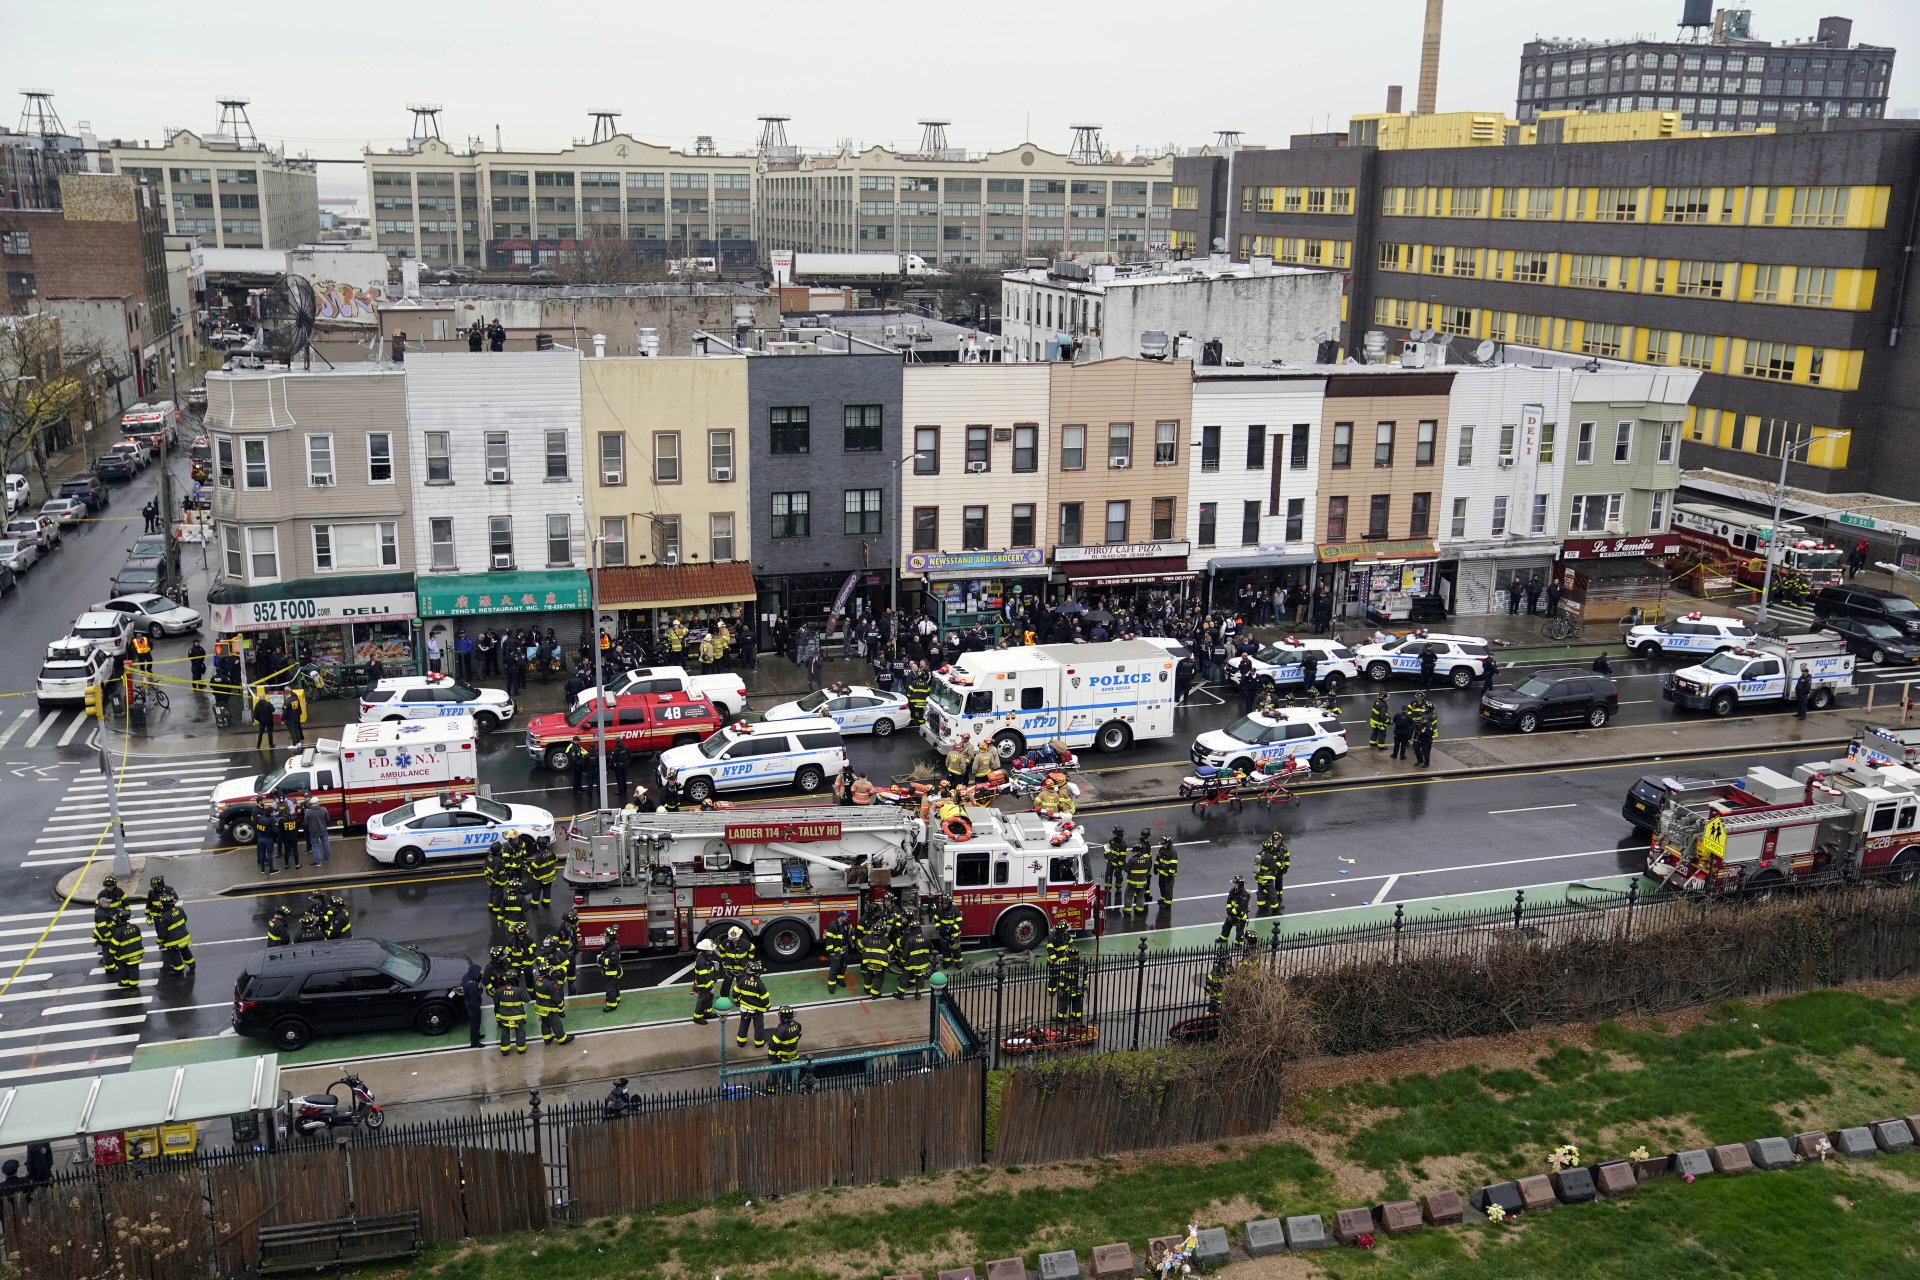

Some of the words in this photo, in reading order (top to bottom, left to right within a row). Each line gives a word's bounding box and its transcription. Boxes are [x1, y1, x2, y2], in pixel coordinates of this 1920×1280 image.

[616, 146, 628, 158] 4
[1526, 416, 1536, 455] DELI
[1084, 547, 1113, 555] SPIRO'S
[1341, 545, 1360, 554] FRUITS
[1592, 540, 1607, 553] La
[1614, 538, 1654, 552] Familia
[929, 557, 973, 565] NEWSSTAND
[993, 554, 1024, 562] GROCERY
[254, 602, 277, 622] 952
[280, 600, 315, 620] FOOD
[317, 608, 332, 616] CORP.
[343, 606, 389, 616] DELI
[1815, 658, 1838, 666] POLICE
[1280, 668, 1300, 678] NYPD
[1089, 673, 1151, 686] POLICE
[1746, 683, 1766, 692] NYPD
[438, 707, 465, 717] NYPD
[664, 707, 681, 720] 48
[1022, 717, 1057, 729] NYPD
[356, 723, 381, 743] FDNY
[620, 730, 645, 739] FDNY
[1262, 748, 1285, 758] NYPD
[368, 757, 393, 768] F.D.
[415, 754, 440, 764] N.Y.
[380, 769, 430, 779] AMBULANCE
[722, 764, 752, 776] NYPD
[284, 822, 296, 830] FBI
[463, 832, 499, 844] NYPD
[728, 829, 763, 840] LADDER
[764, 827, 779, 838] 114
[798, 826, 825, 837] TALLY
[826, 825, 839, 836] HO
[1704, 840, 1724, 853] SCHOOL
[1873, 837, 1890, 849] 228
[575, 848, 587, 861] 114
[963, 895, 982, 905] 114
